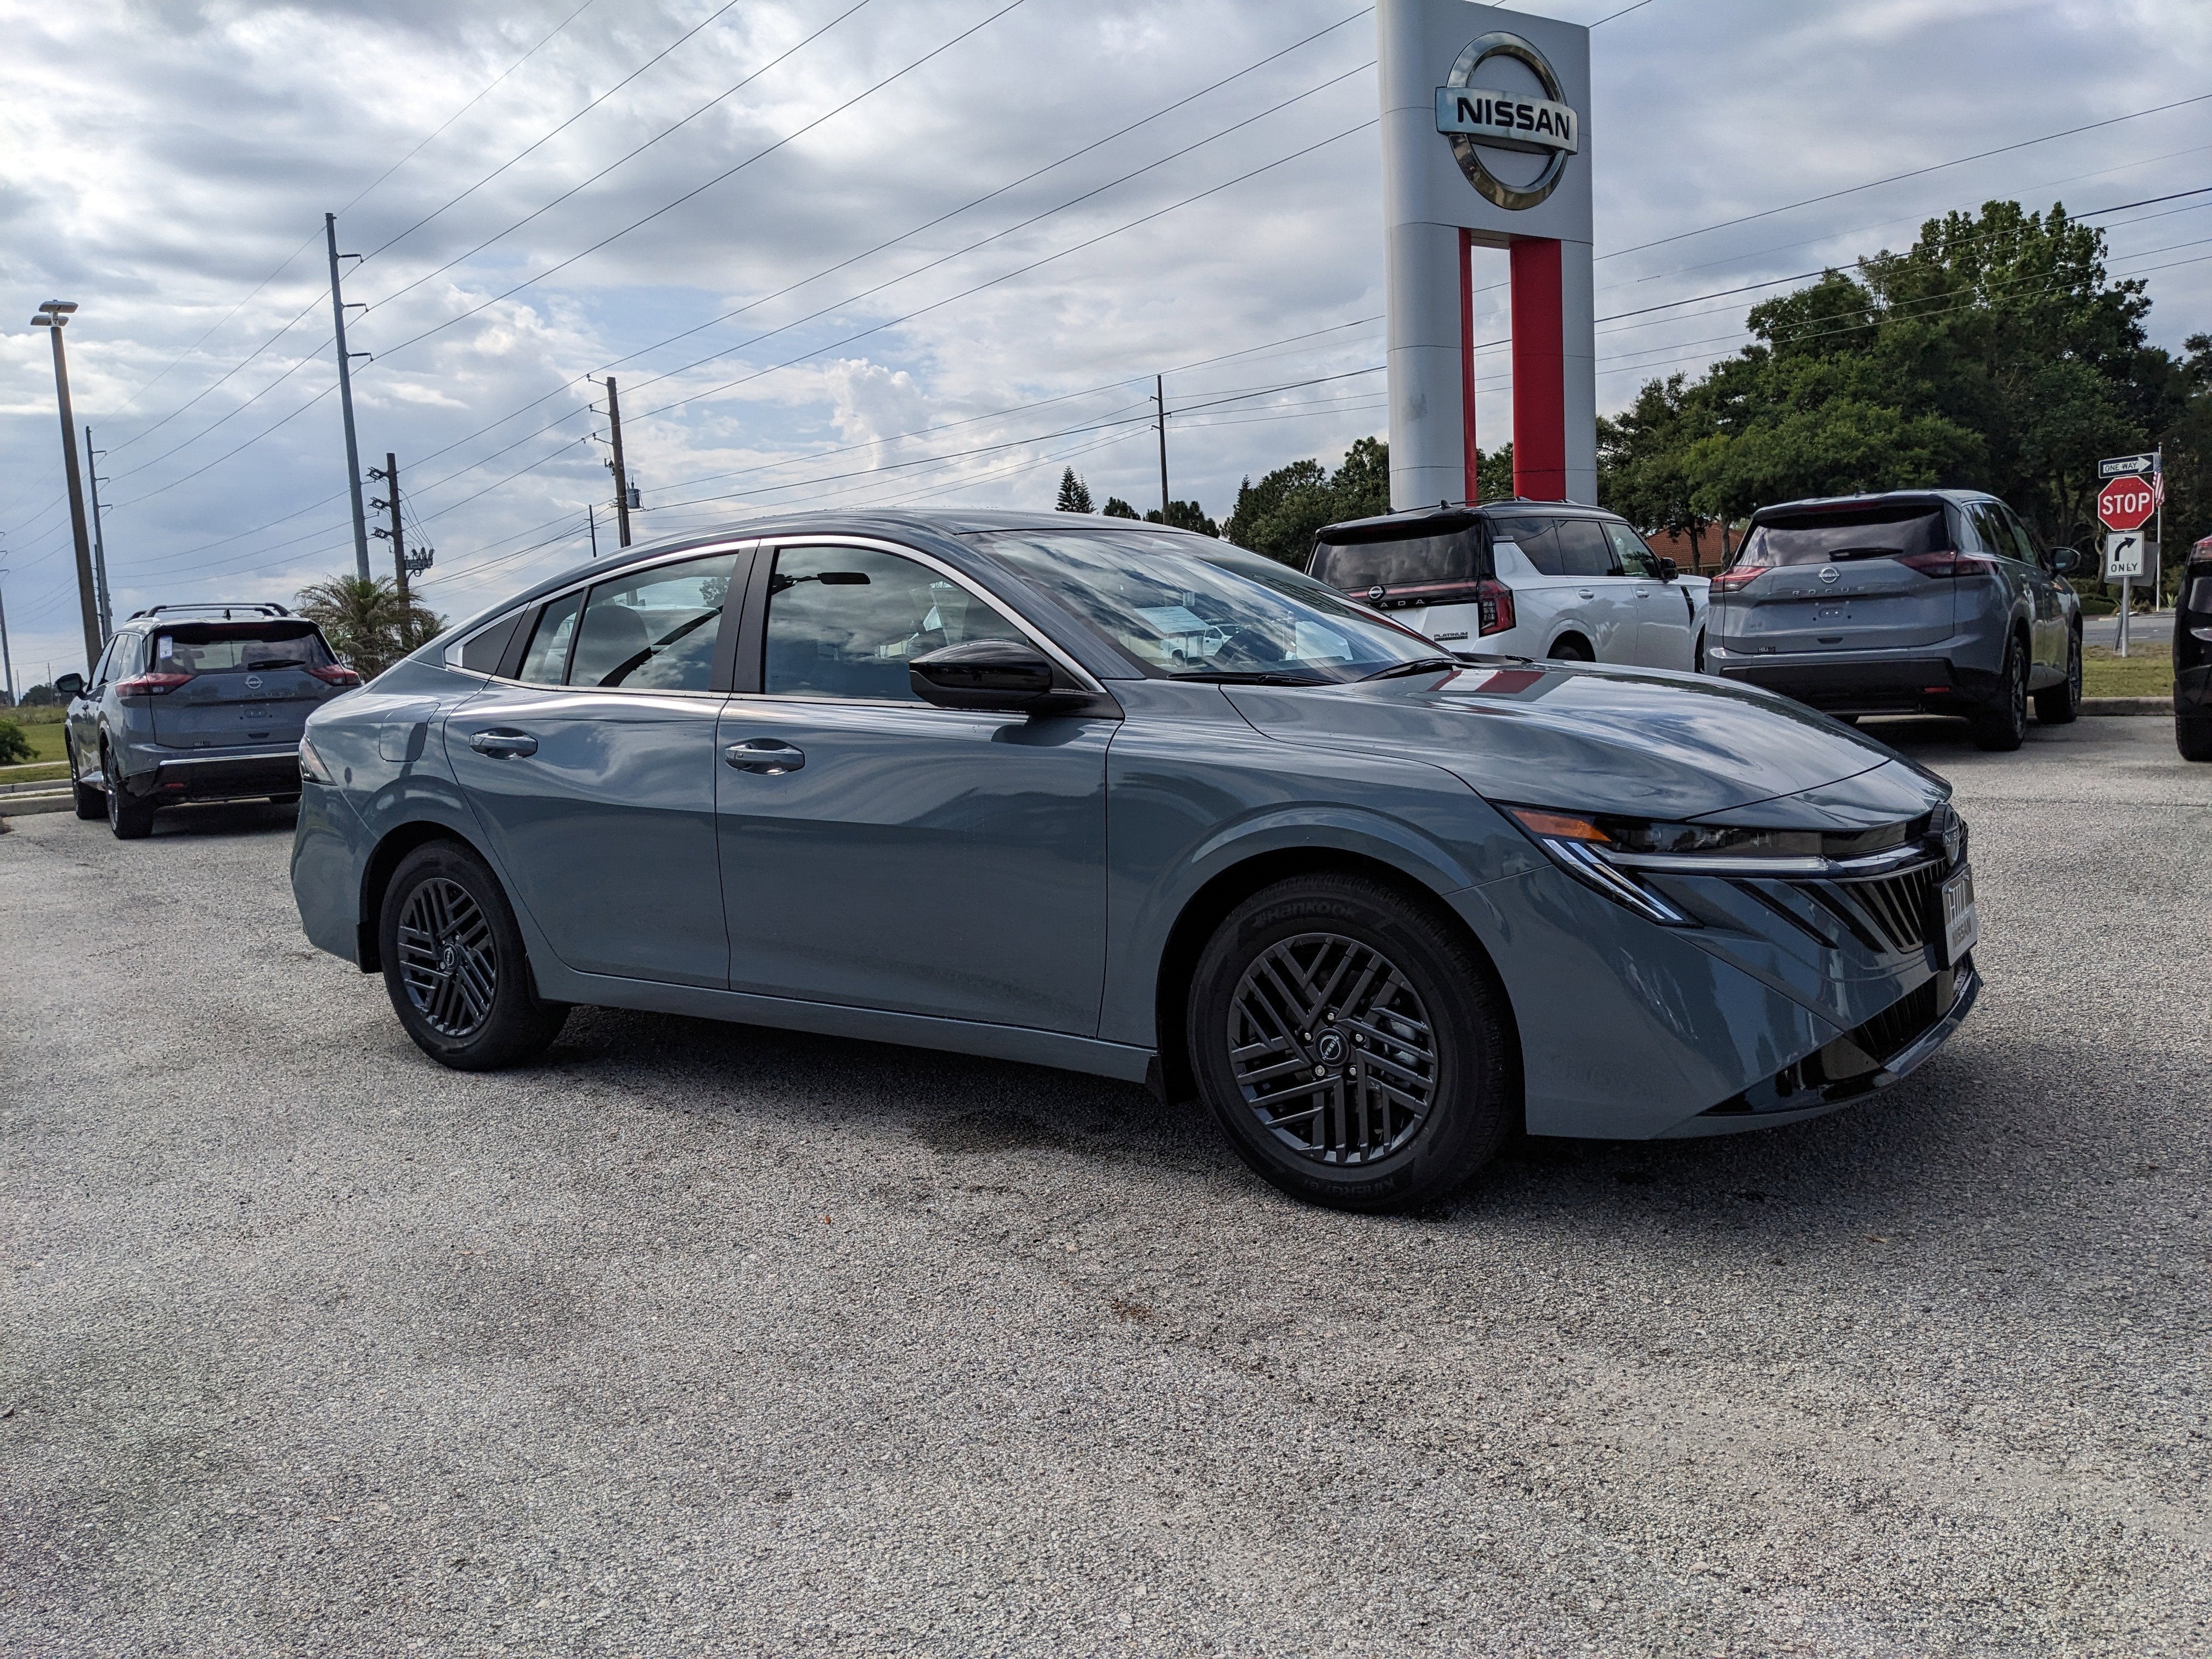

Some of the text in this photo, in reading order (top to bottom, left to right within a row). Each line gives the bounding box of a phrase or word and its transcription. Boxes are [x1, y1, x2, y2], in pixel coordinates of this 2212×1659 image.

[1457, 97, 1571, 140] NISSAN
[2121, 461, 2137, 470] WAY
[2102, 492, 2150, 515] STOP
[2111, 563, 2138, 572] ONLY
[1368, 599, 1425, 608] ADA
[1949, 880, 1969, 928] HILL
[1953, 916, 1972, 948] NISSAN
[1322, 1035, 1340, 1060] NISSAN
